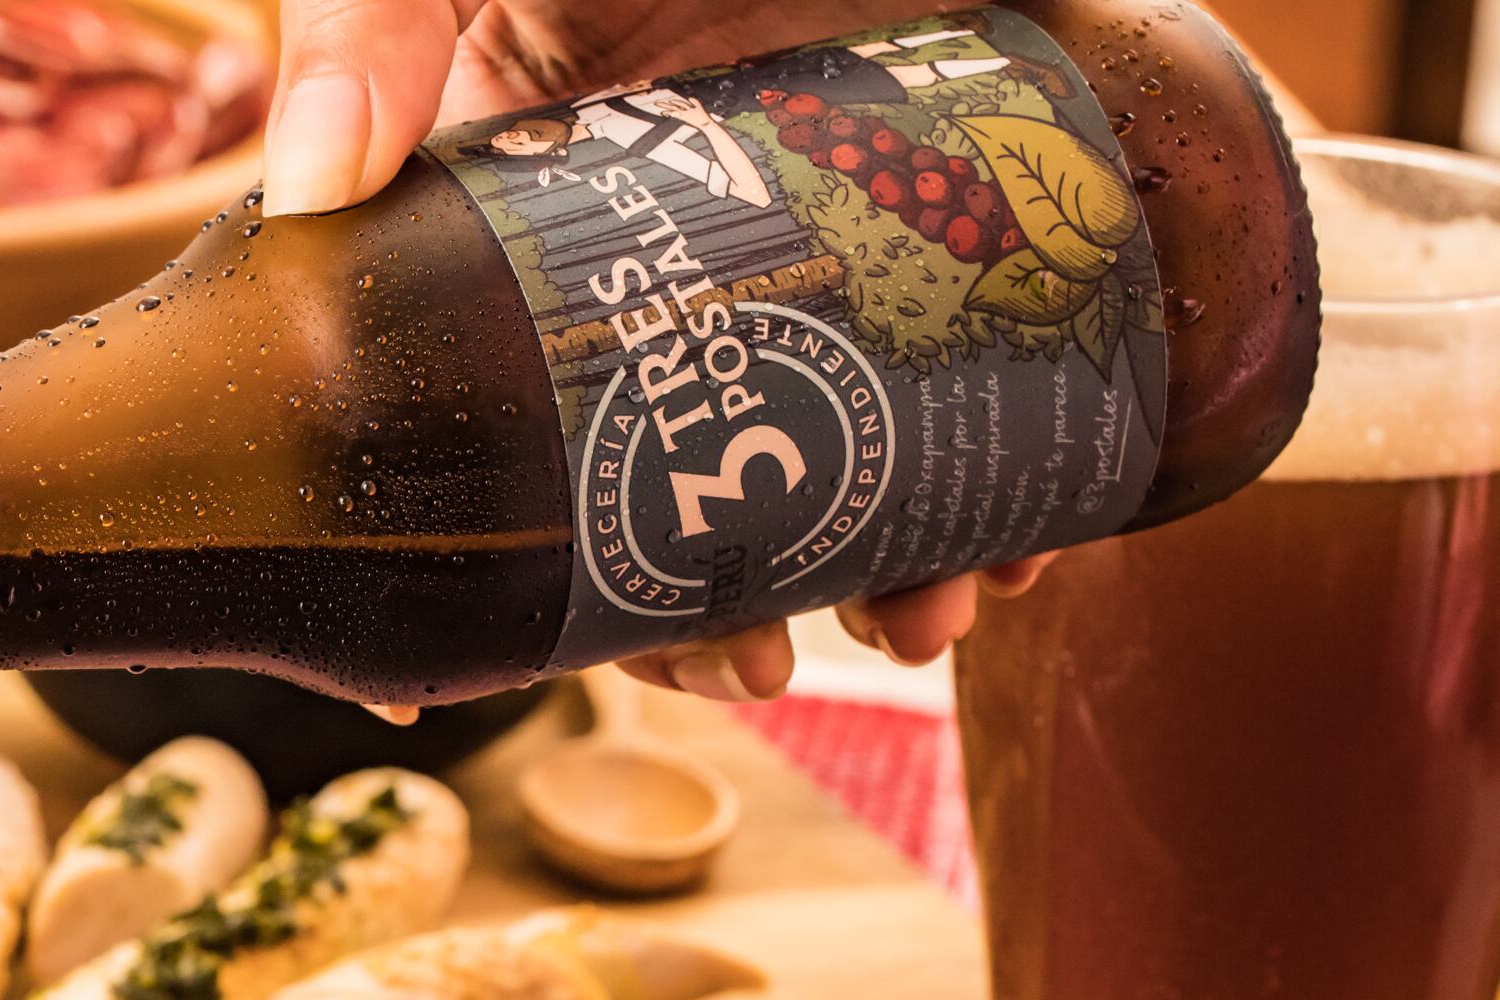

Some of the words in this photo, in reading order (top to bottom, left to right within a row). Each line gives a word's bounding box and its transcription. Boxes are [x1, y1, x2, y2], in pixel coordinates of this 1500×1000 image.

[588, 166, 766, 422] POSTALES
[587, 256, 715, 454] TRES
[947, 375, 966, 403] la
[668, 424, 807, 538] 3
[753, 318, 882, 565] INDEPENDIENTE
[915, 374, 946, 495] Oxapampa
[954, 411, 978, 450] por
[978, 371, 1010, 485] inspirada
[1045, 449, 1064, 475] te
[1077, 389, 1119, 515] @3postales
[596, 415, 681, 605] CERVECERÍA
[937, 456, 968, 538] cafetales
[972, 487, 996, 539] postal
